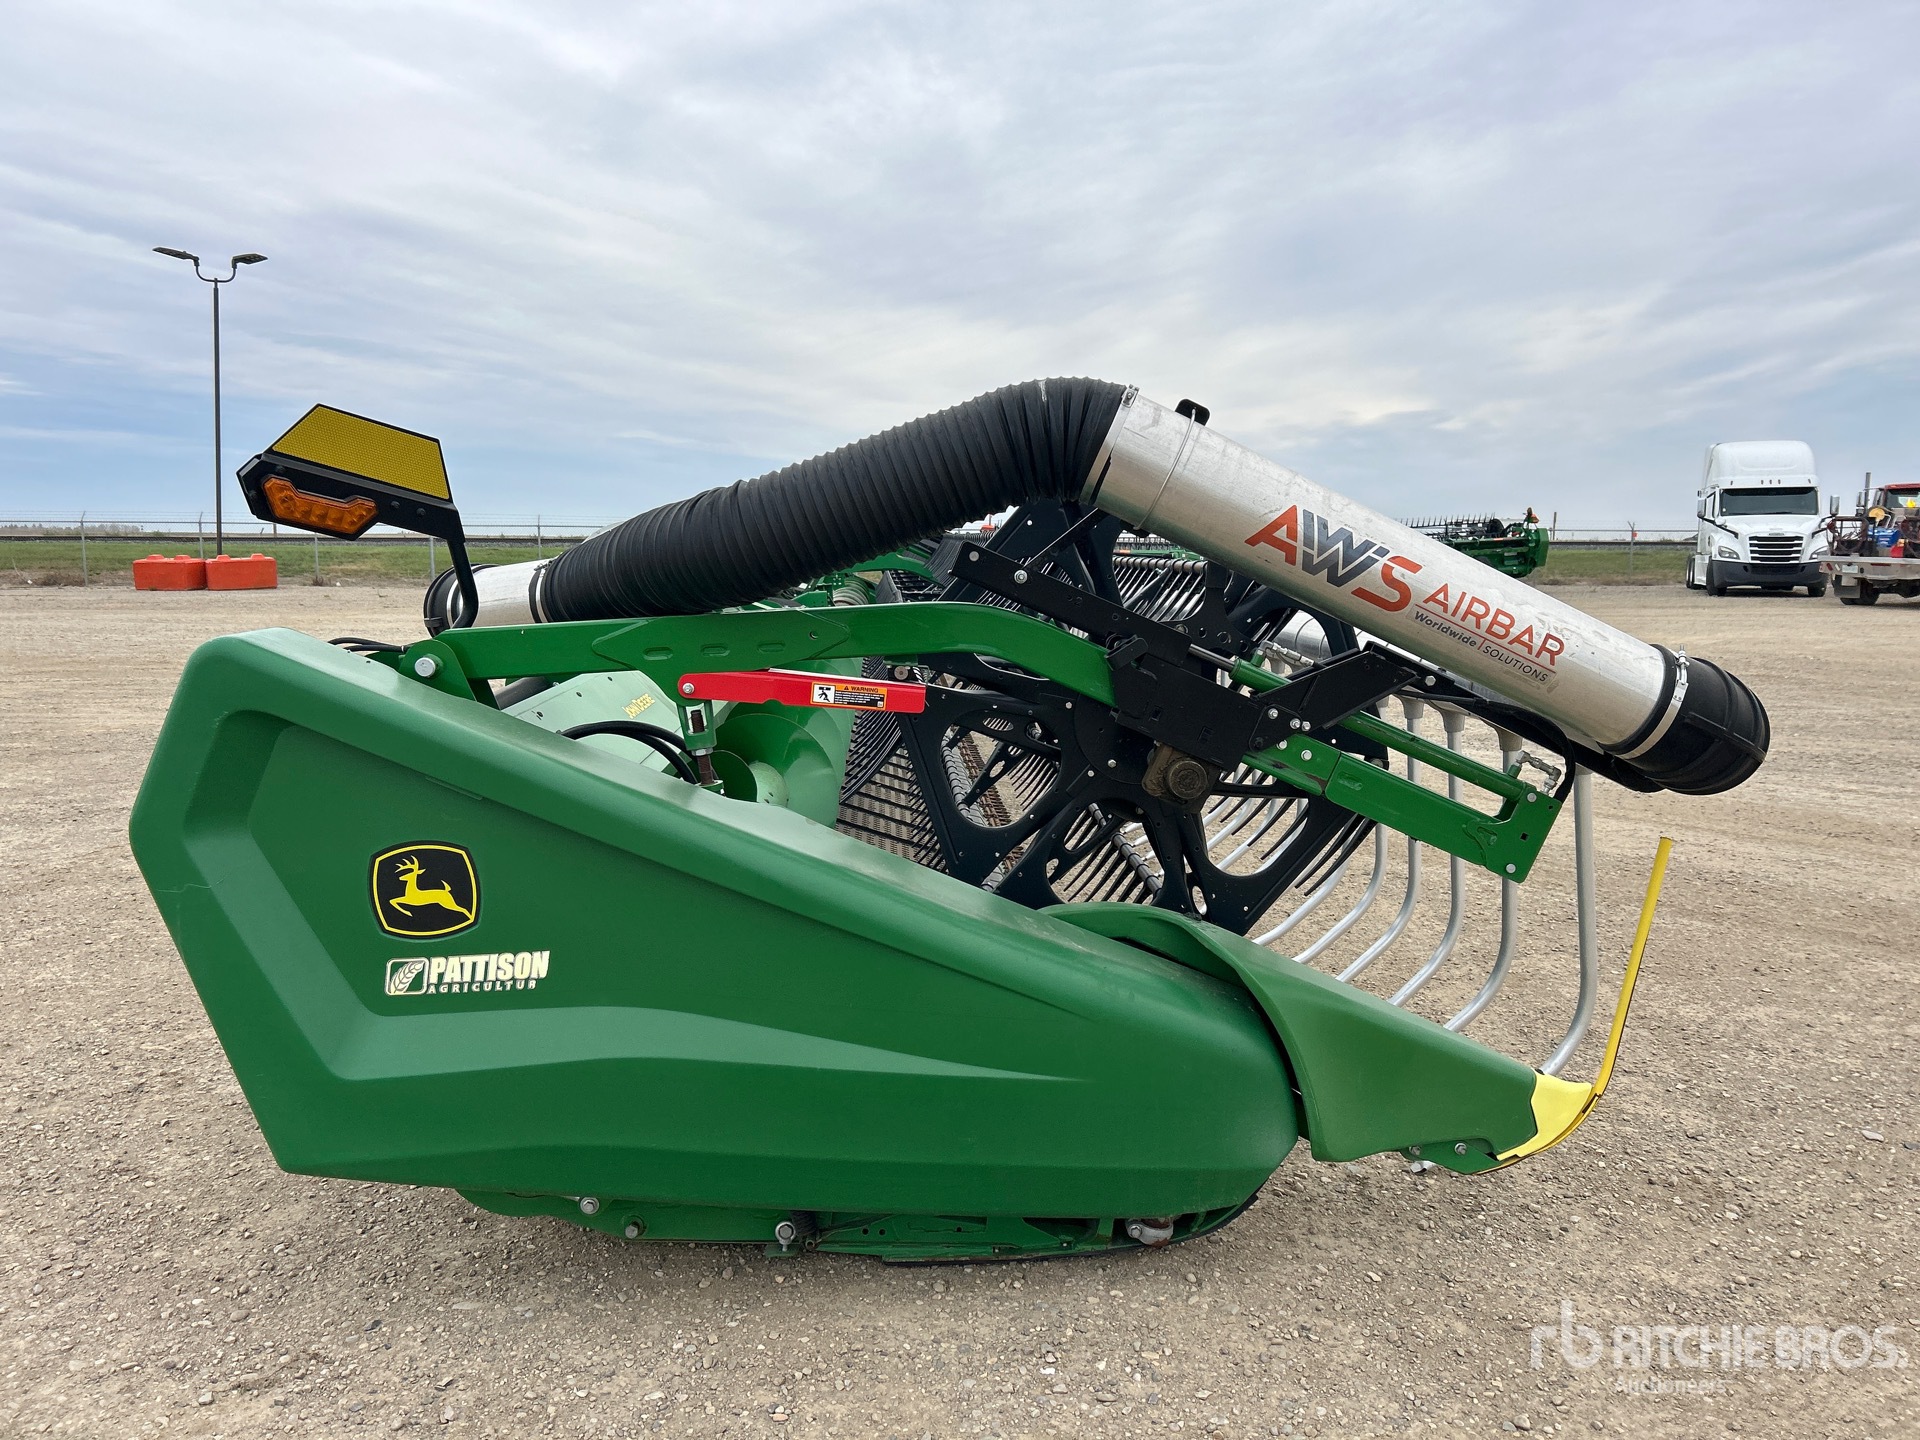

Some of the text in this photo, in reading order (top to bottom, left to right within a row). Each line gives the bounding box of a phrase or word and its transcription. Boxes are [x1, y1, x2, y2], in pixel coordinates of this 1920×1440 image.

[1244, 504, 1423, 612] AWS
[1422, 583, 1565, 667] AIRBAR
[1414, 611, 1549, 682] Worldwide SOLUTIONS
[632, 693, 656, 712] DEERE
[851, 685, 879, 693] WARNING
[428, 950, 550, 984] PATTISON
[426, 980, 536, 995] AGRICULTUR
